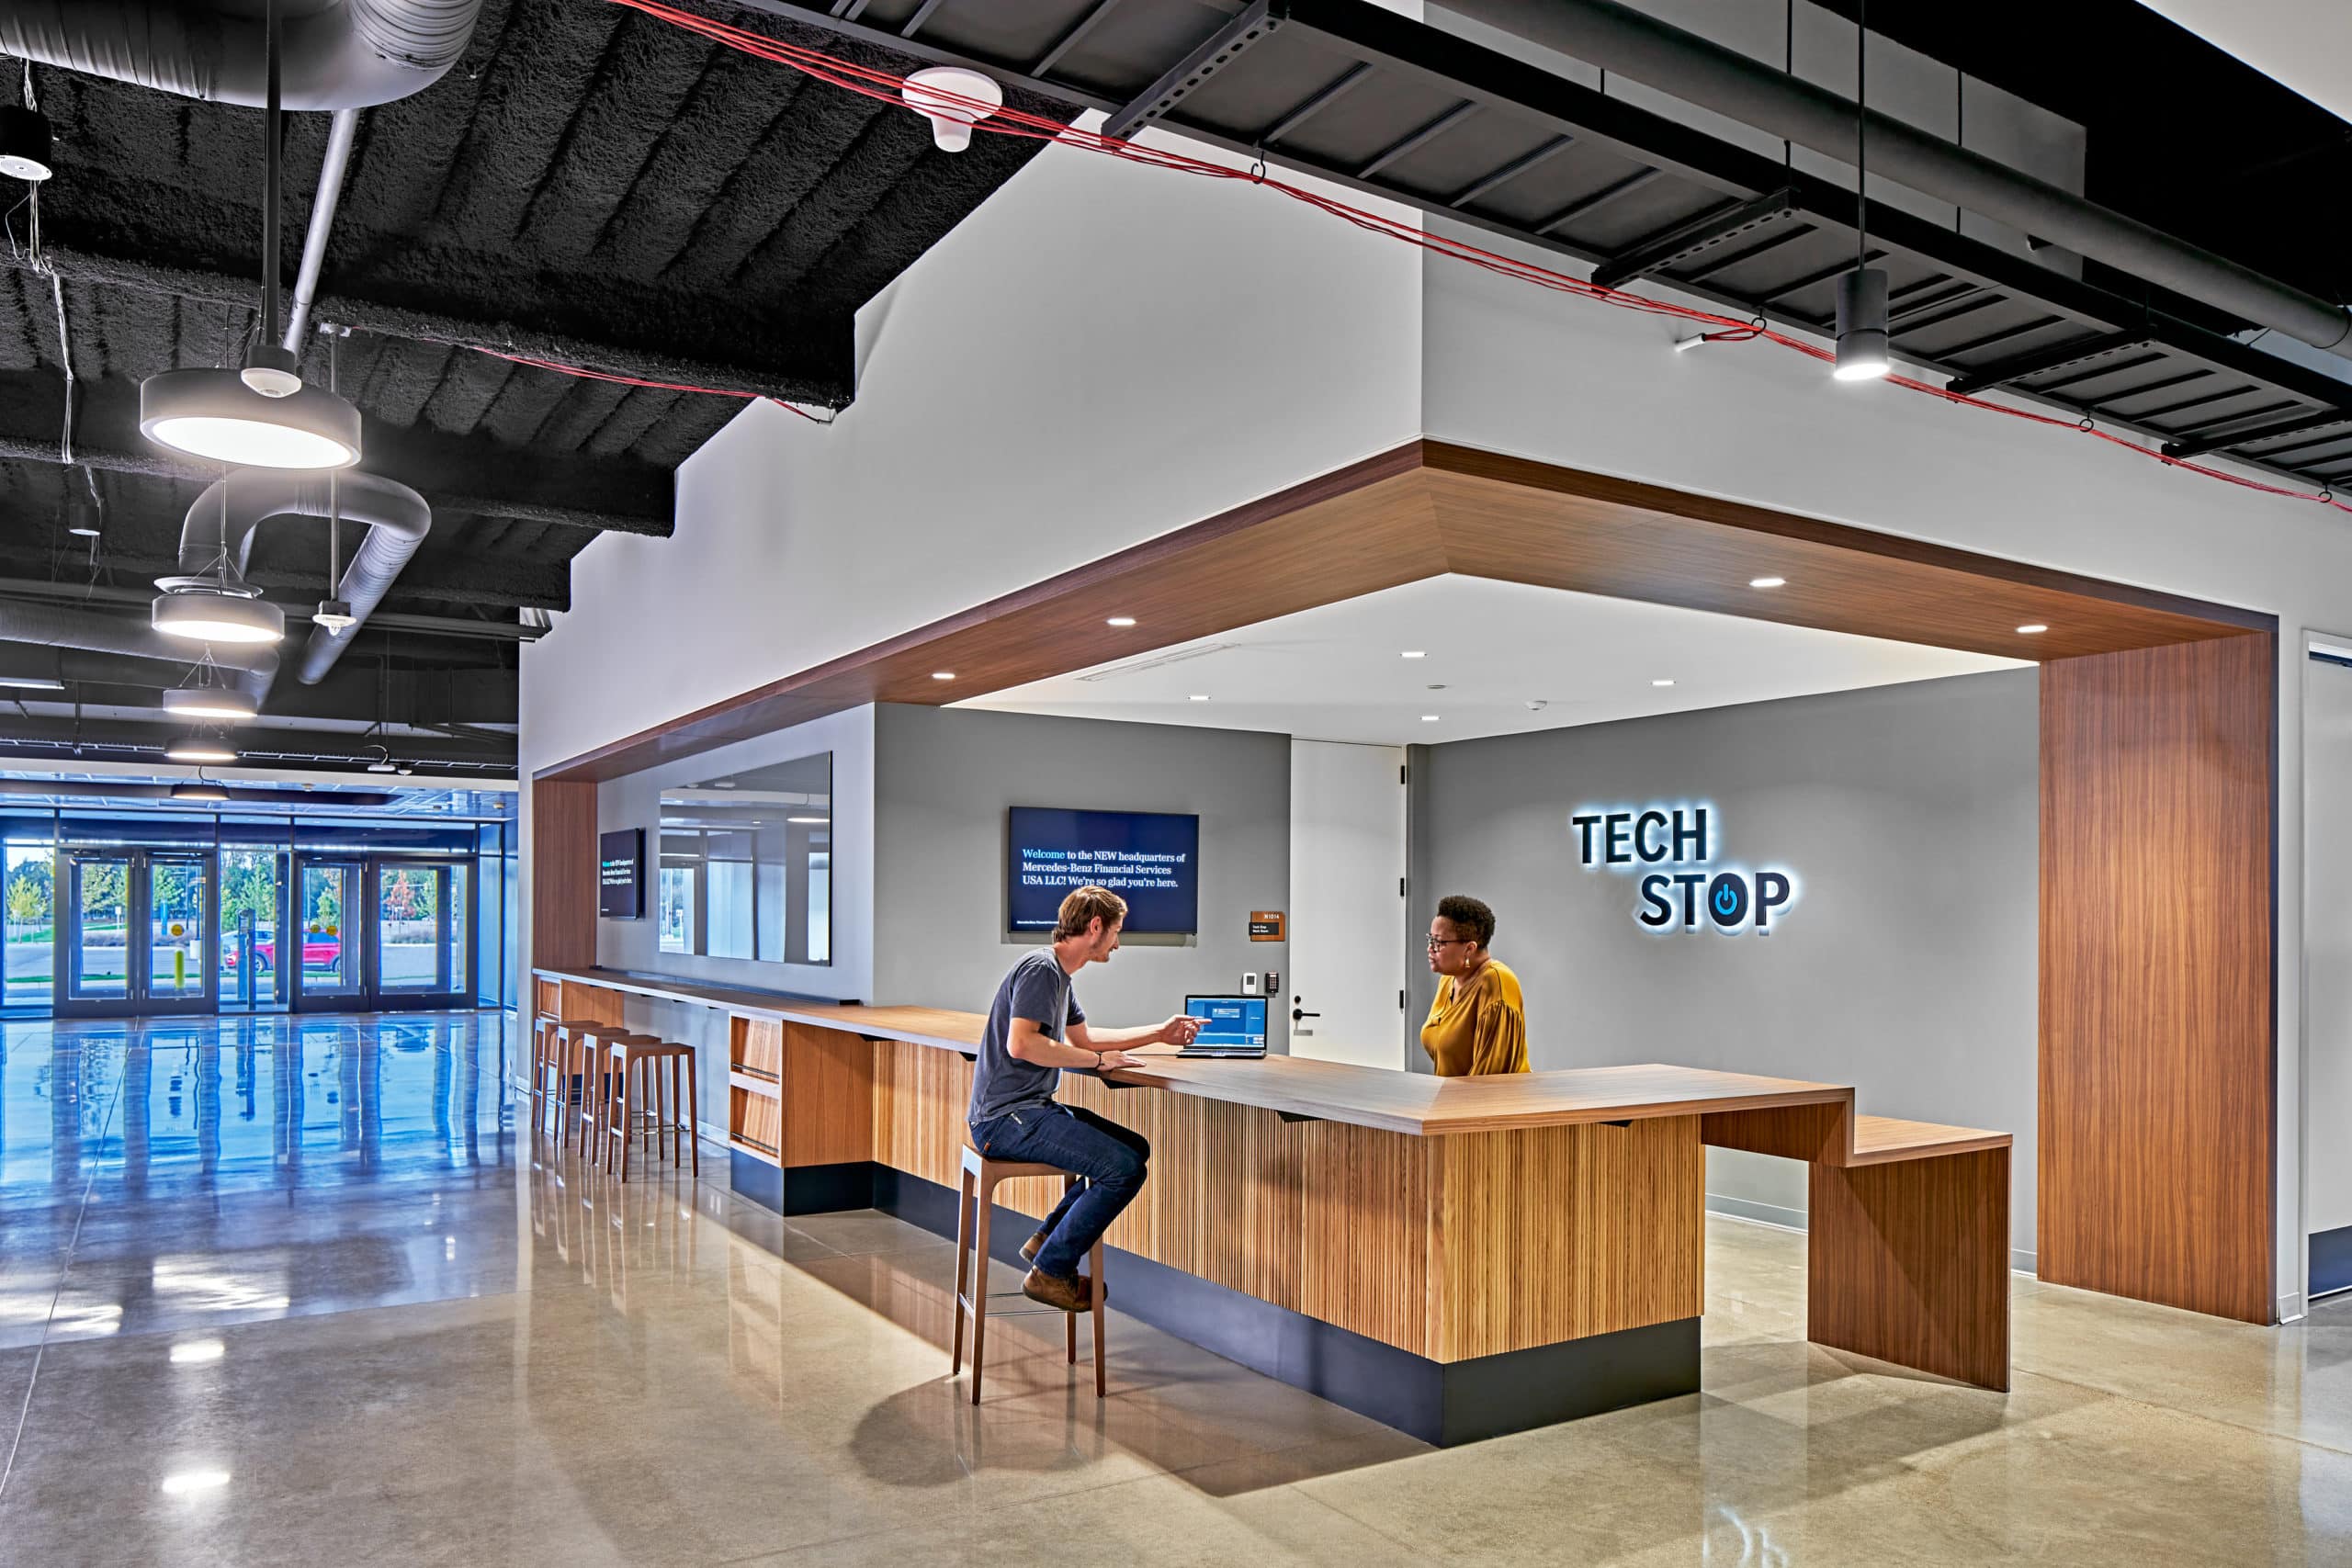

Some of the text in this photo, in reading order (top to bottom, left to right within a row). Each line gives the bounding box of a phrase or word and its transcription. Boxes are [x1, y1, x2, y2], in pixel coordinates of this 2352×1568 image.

[1573, 809, 1706, 863] TECH
[1023, 849, 1186, 863] Welcome to the NEW headquarters of
[1023, 862, 1171, 874] Mercedes-Benz Financial Services
[1023, 874, 1044, 885] USA
[1045, 875, 1067, 886] LLC!
[1068, 876, 1094, 886] We're
[1107, 877, 1126, 888] glad
[1127, 877, 1156, 888] you're
[1157, 877, 1179, 887] here.
[1640, 873, 1790, 927] STOP
